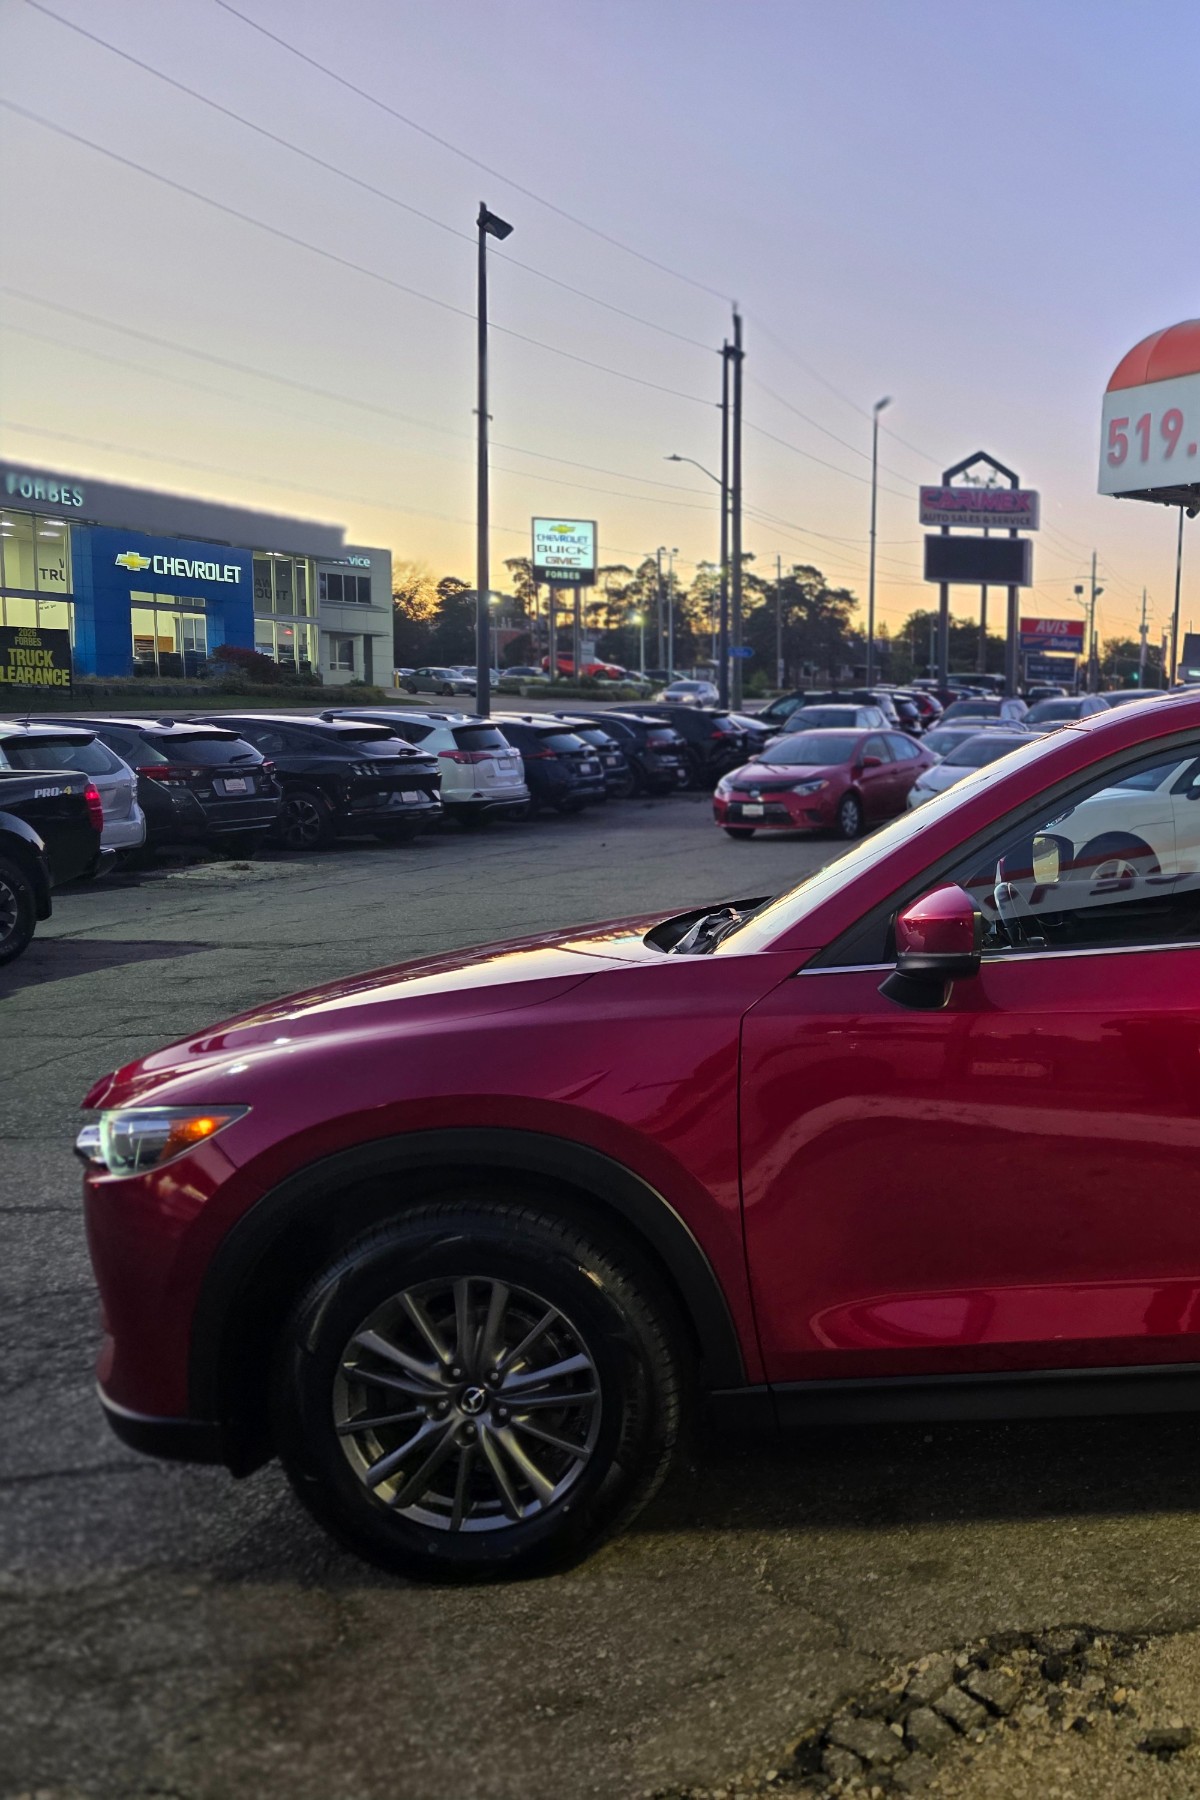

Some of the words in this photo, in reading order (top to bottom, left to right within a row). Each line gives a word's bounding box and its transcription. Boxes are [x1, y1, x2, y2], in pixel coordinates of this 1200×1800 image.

[6, 473, 84, 507] FORBES
[923, 513, 949, 521] AUTO
[951, 513, 980, 523] SALES
[993, 515, 1031, 525] SERVICE
[537, 533, 588, 545] CHEVROLET
[537, 545, 589, 555] BUICK
[545, 556, 581, 565] GMC
[153, 555, 241, 584] CHEVROLET
[545, 570, 580, 580] FORBES
[1035, 620, 1069, 634] AVIS
[14, 636, 42, 647] FORBES
[8, 648, 54, 667] TRUCK
[34, 785, 80, 798] PRO-4
